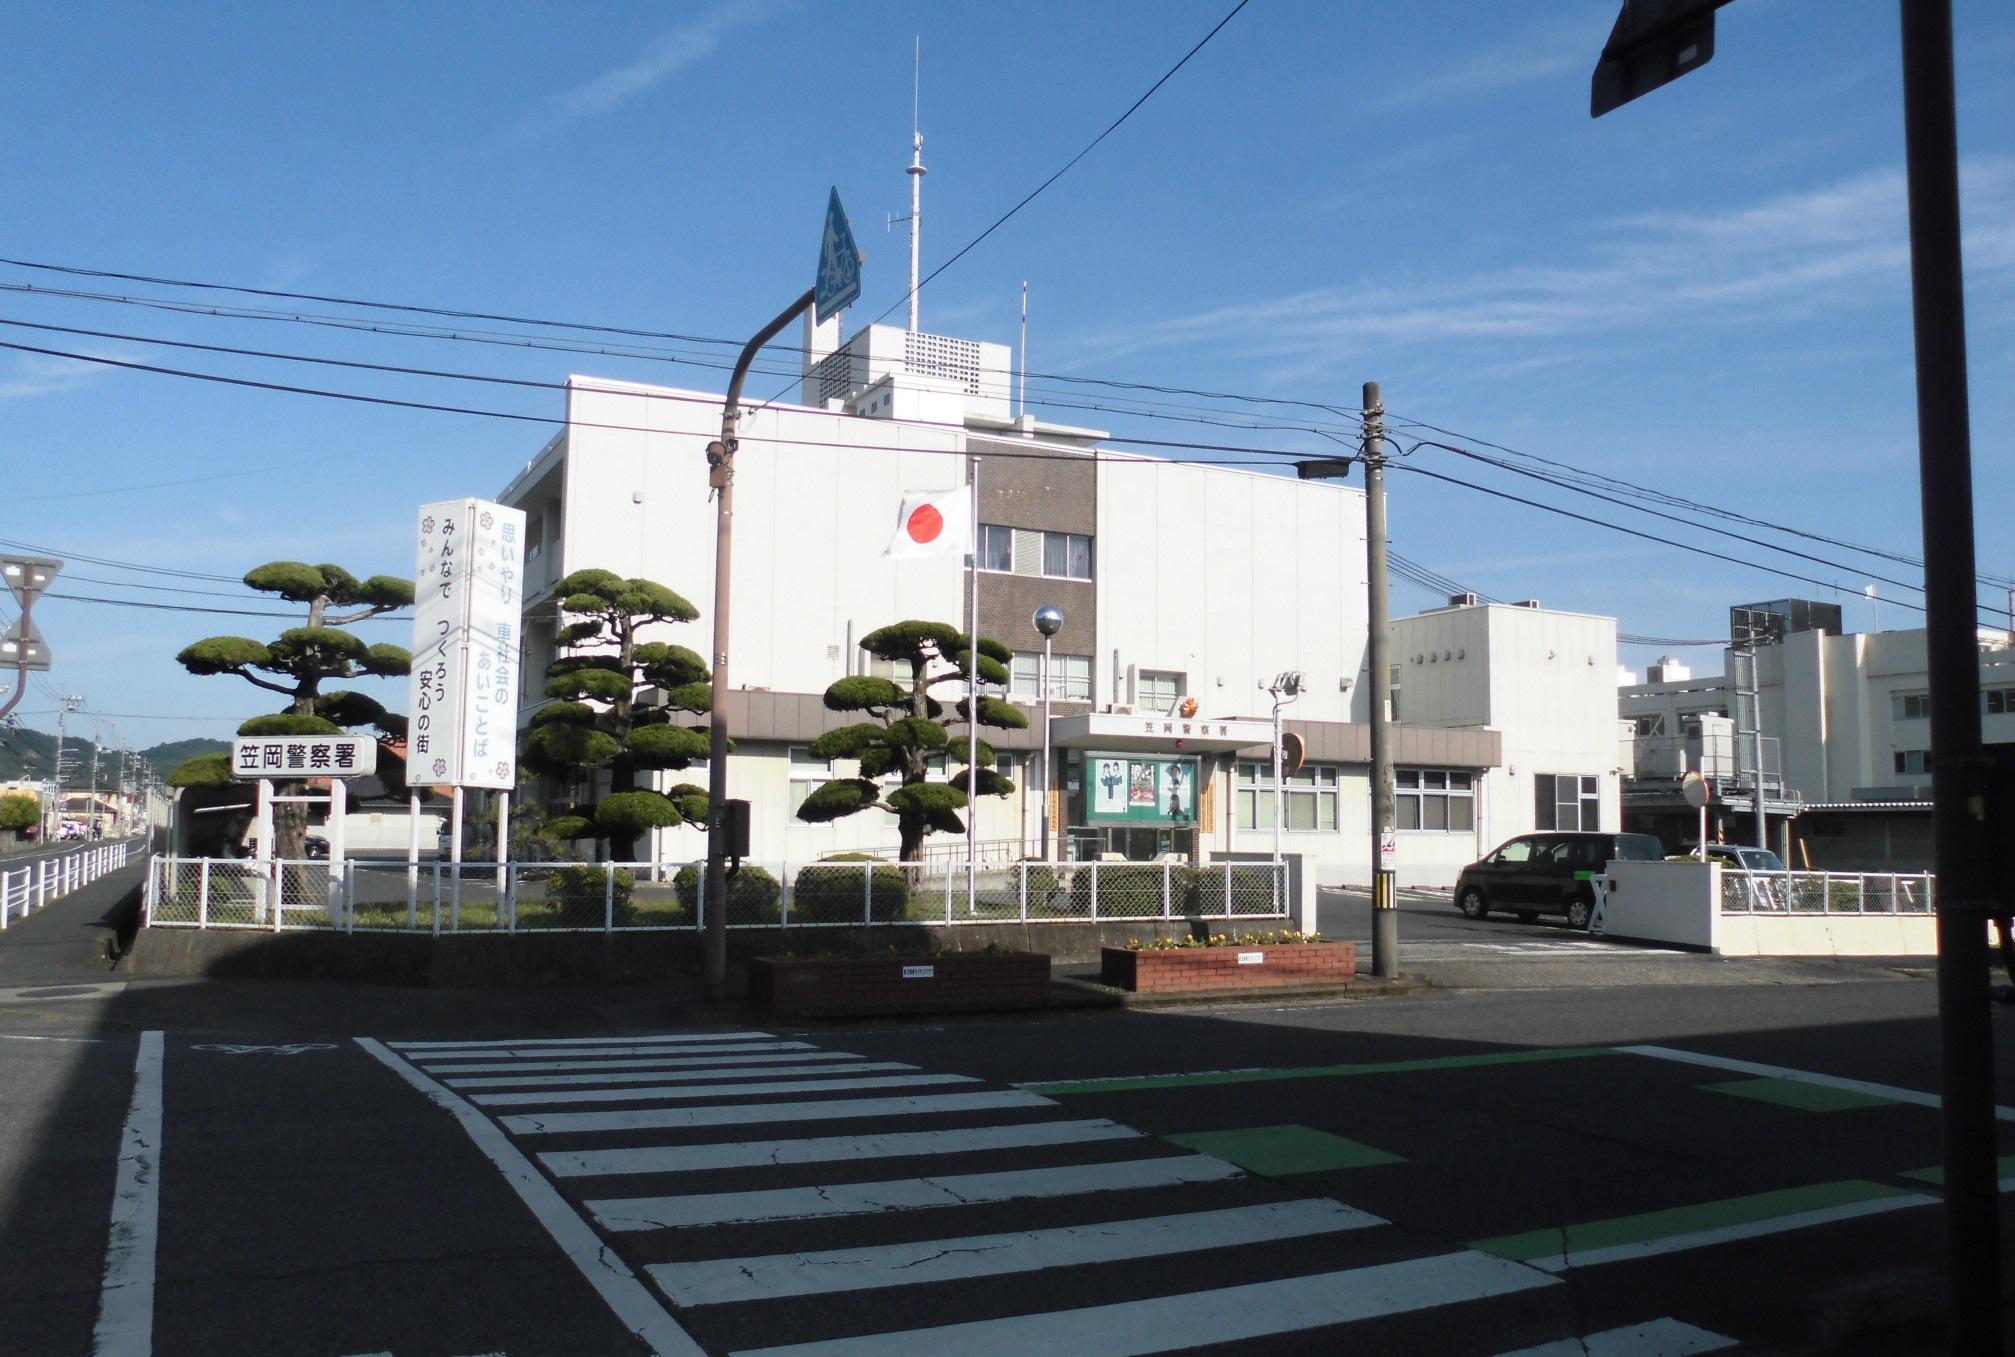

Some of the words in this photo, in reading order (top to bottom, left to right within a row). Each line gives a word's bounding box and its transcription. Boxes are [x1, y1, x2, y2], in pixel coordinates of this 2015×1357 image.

[439, 518, 456, 600] みんなで
[500, 521, 516, 606] 思いやり
[434, 618, 450, 703] つくろう
[494, 622, 511, 705] 車社会の
[416, 669, 433, 755] 安心の街
[472, 650, 491, 758] あいことば
[1144, 721, 1228, 736] 笠岡警察署
[239, 743, 356, 769] 笠岡警察署
